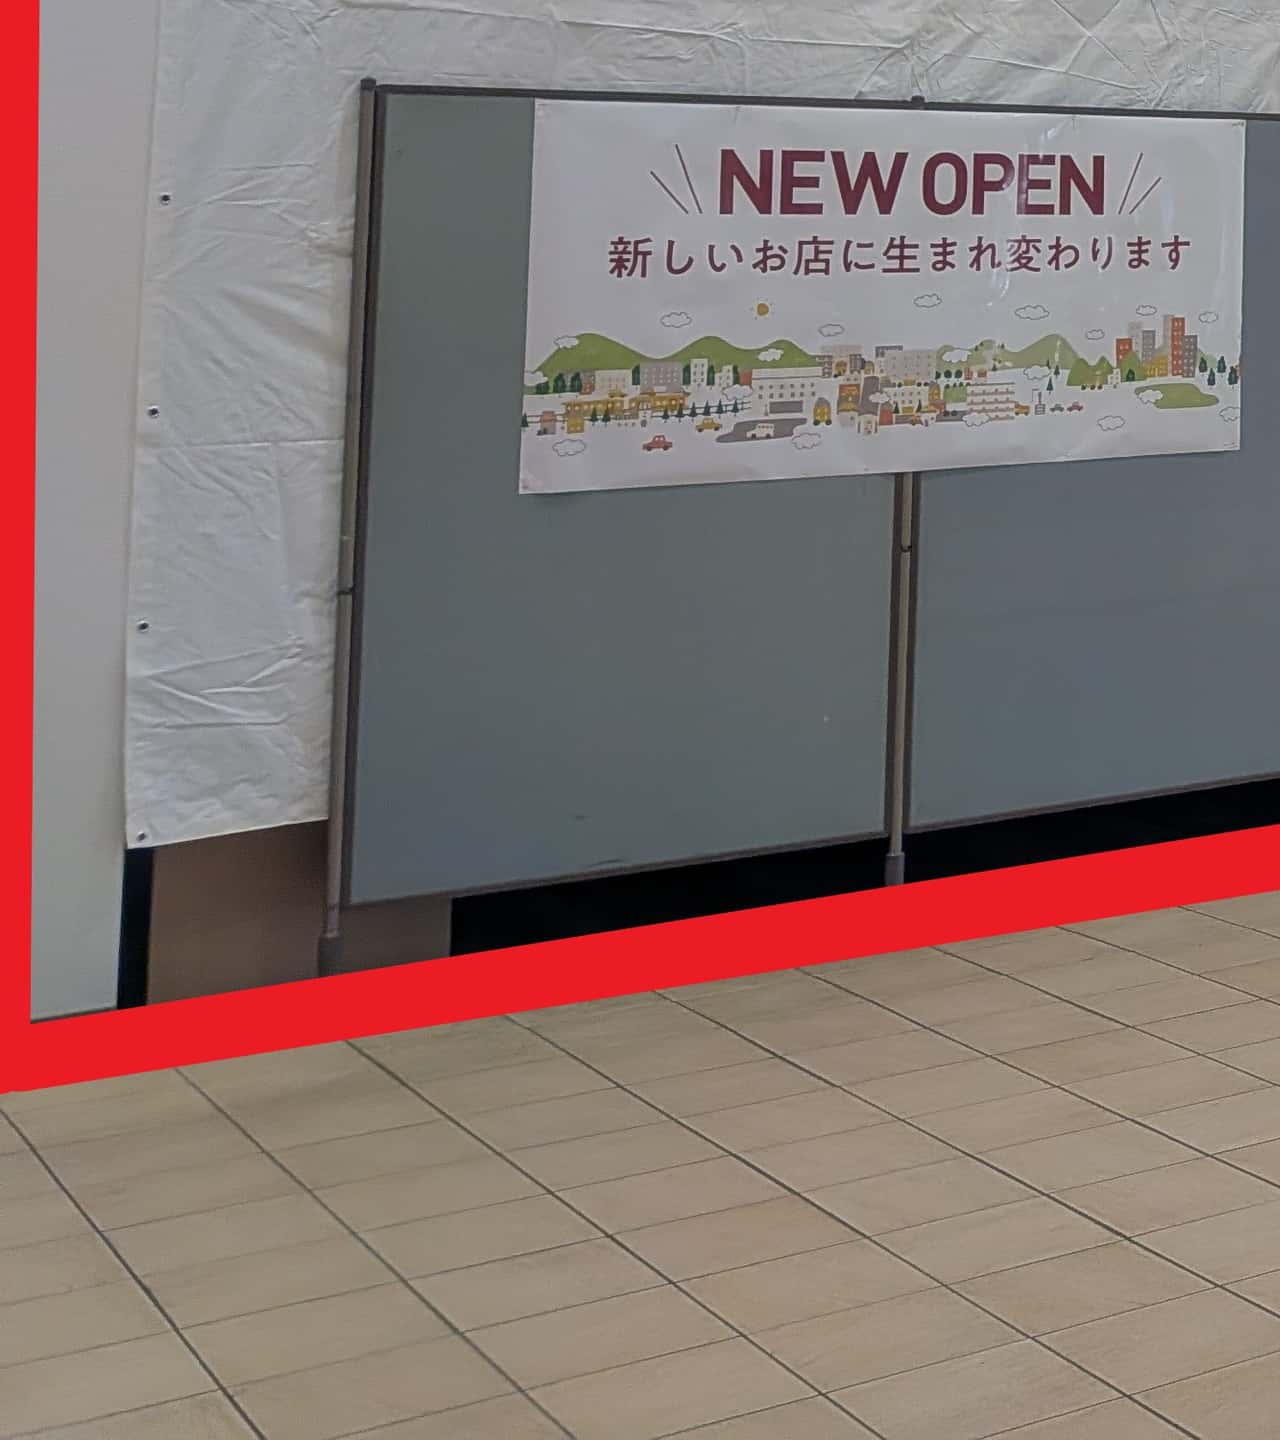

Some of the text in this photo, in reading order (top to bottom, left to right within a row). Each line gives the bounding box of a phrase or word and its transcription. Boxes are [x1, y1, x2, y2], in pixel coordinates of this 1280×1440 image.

[717, 148, 1106, 216] NEW OPEN
[606, 233, 1194, 279] 新しいお店に生まれ変わります
